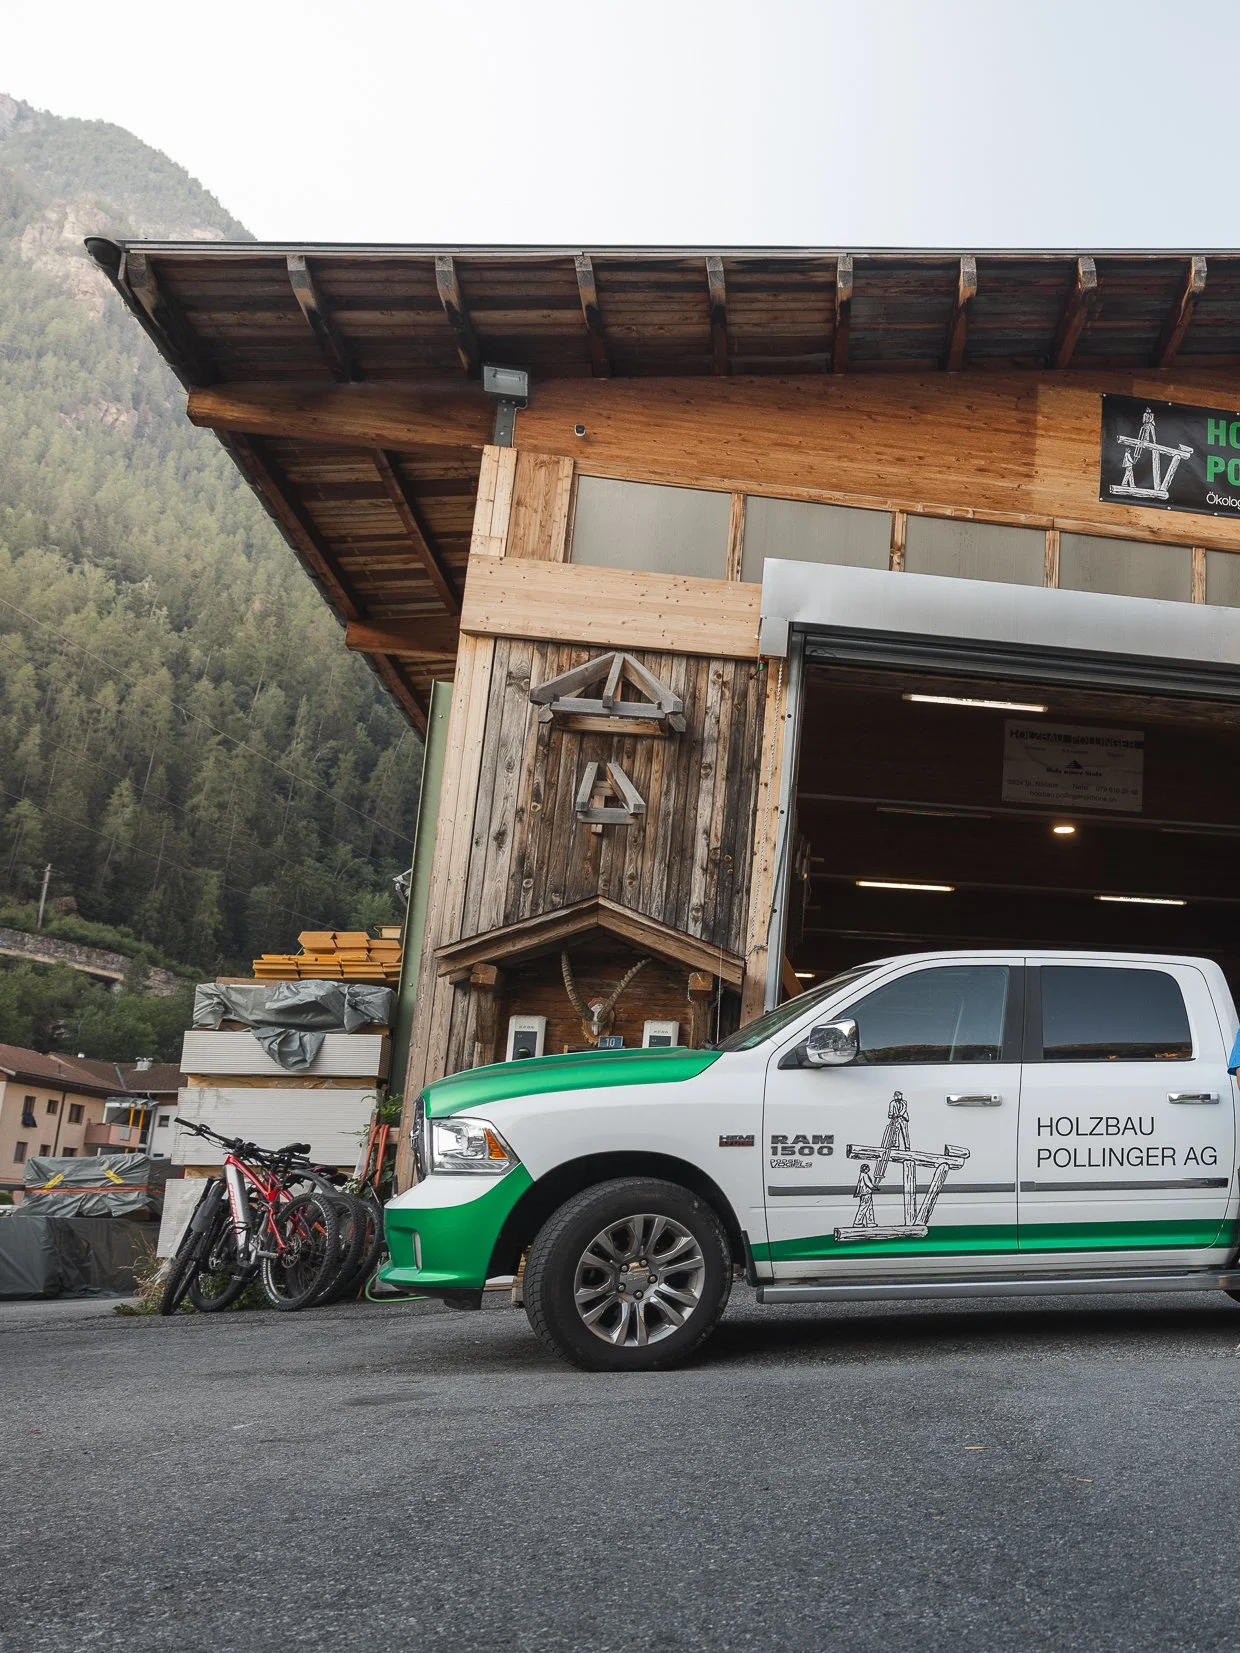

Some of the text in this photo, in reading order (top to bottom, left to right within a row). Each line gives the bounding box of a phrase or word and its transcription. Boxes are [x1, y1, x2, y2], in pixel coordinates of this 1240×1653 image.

[605, 1038, 616, 1047] 10
[1037, 1116, 1155, 1137] HOLZBAU
[771, 1135, 834, 1144] RAM
[770, 1146, 834, 1156] 1500
[1037, 1146, 1218, 1168] POLLINGER AG
